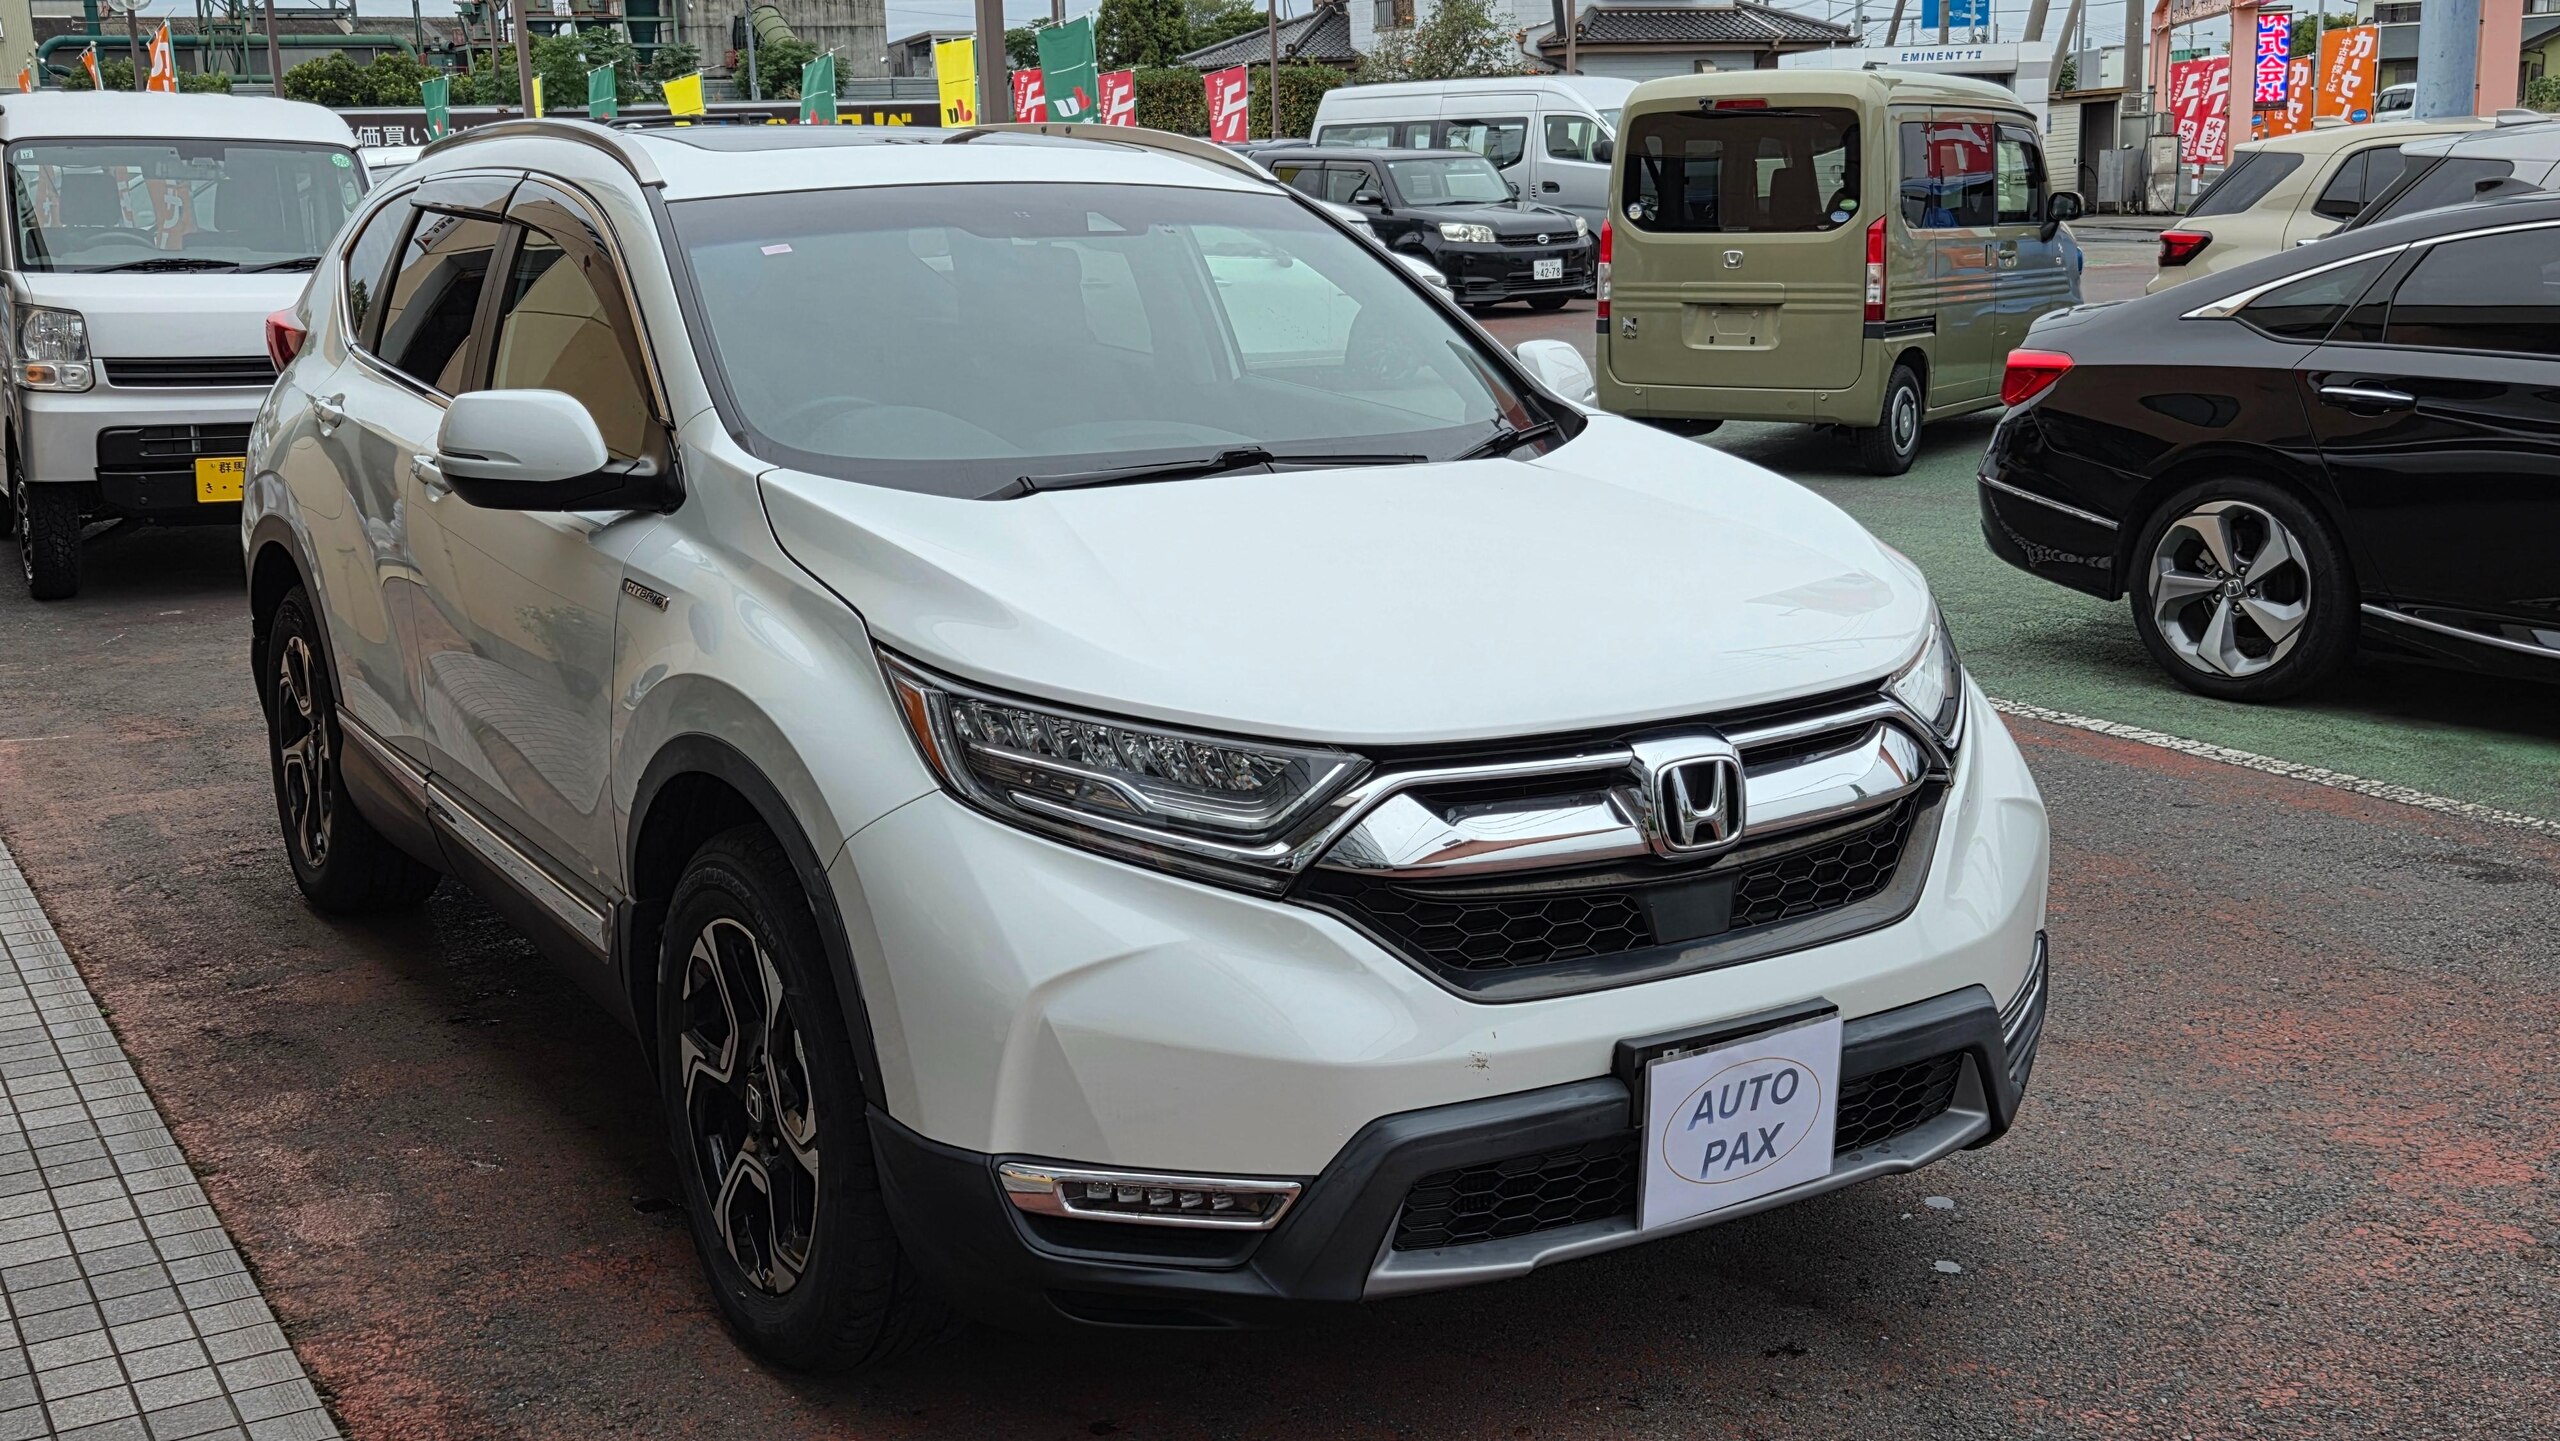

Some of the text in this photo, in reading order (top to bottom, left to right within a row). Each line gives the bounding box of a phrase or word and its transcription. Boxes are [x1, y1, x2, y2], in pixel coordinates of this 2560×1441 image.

[1901, 51, 1963, 62] EMINENT
[219, 461, 243, 473] 群馬
[625, 581, 665, 609] HYBRID
[1687, 1067, 1799, 1131] AUTO
[1700, 1122, 1785, 1179] PAX
